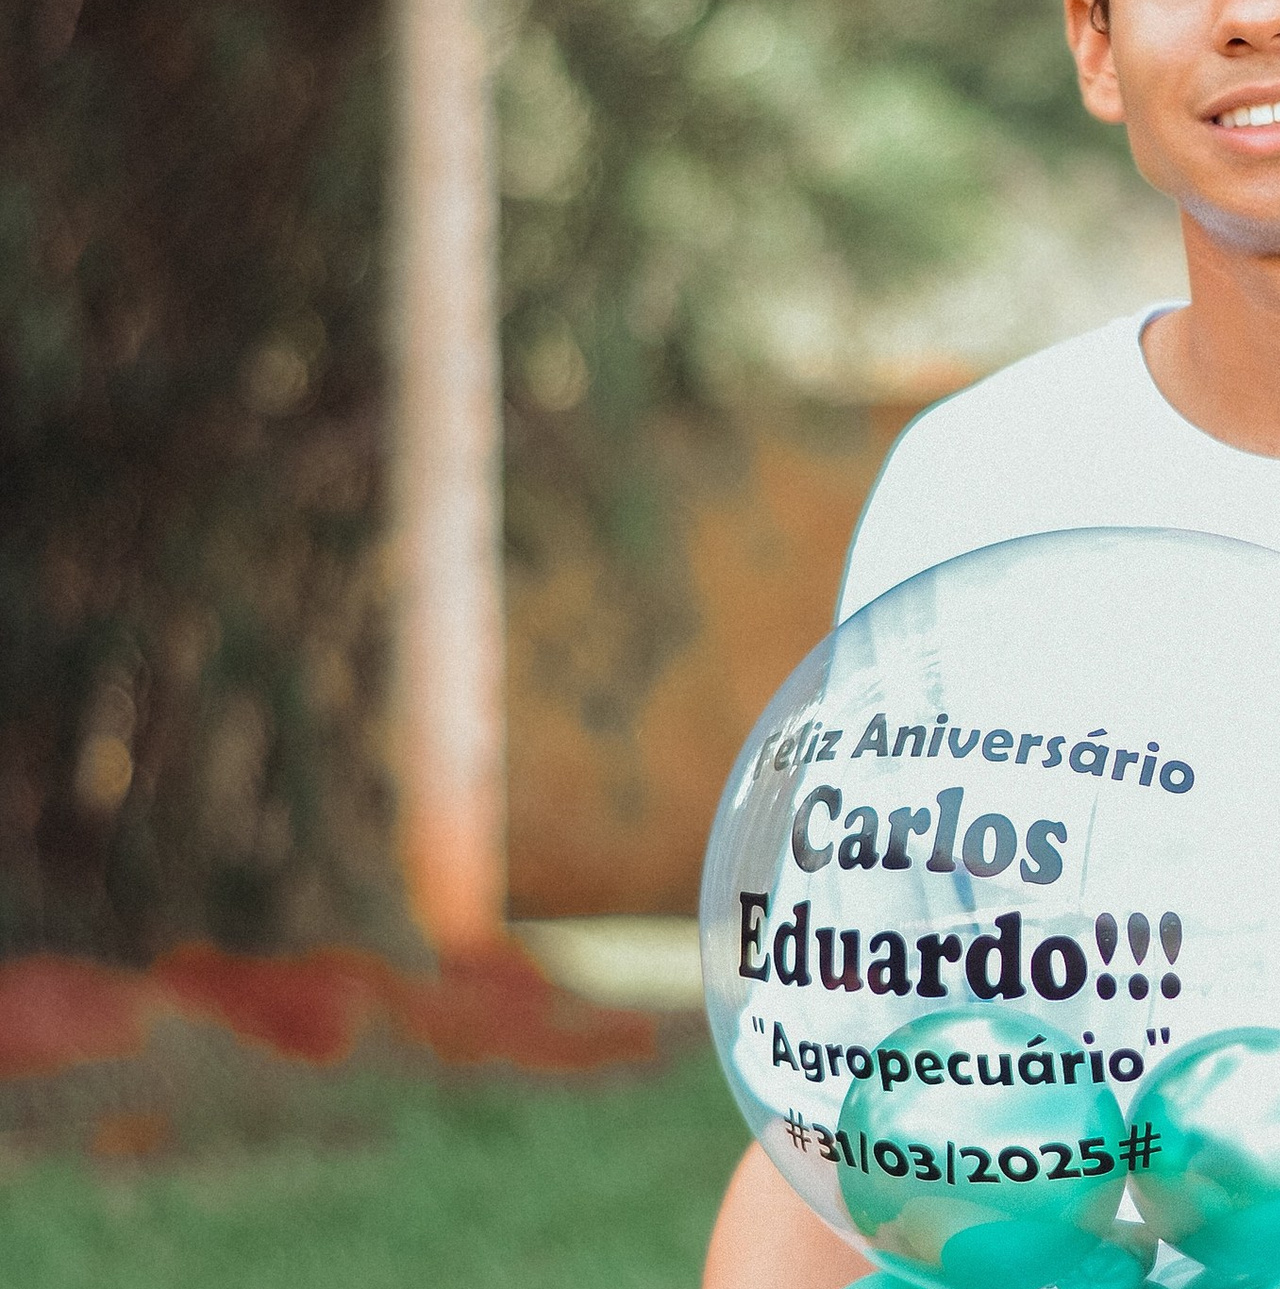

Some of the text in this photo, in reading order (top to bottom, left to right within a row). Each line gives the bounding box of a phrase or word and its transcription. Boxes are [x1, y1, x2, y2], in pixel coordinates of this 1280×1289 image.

[752, 713, 1196, 794] Feliz Aniversário
[791, 784, 1068, 885] Carlos
[738, 891, 1183, 1001] Eduardo!!!
[751, 1015, 1172, 1092] "Agropecuário"
[784, 1108, 1162, 1184] #31/03/2025#
